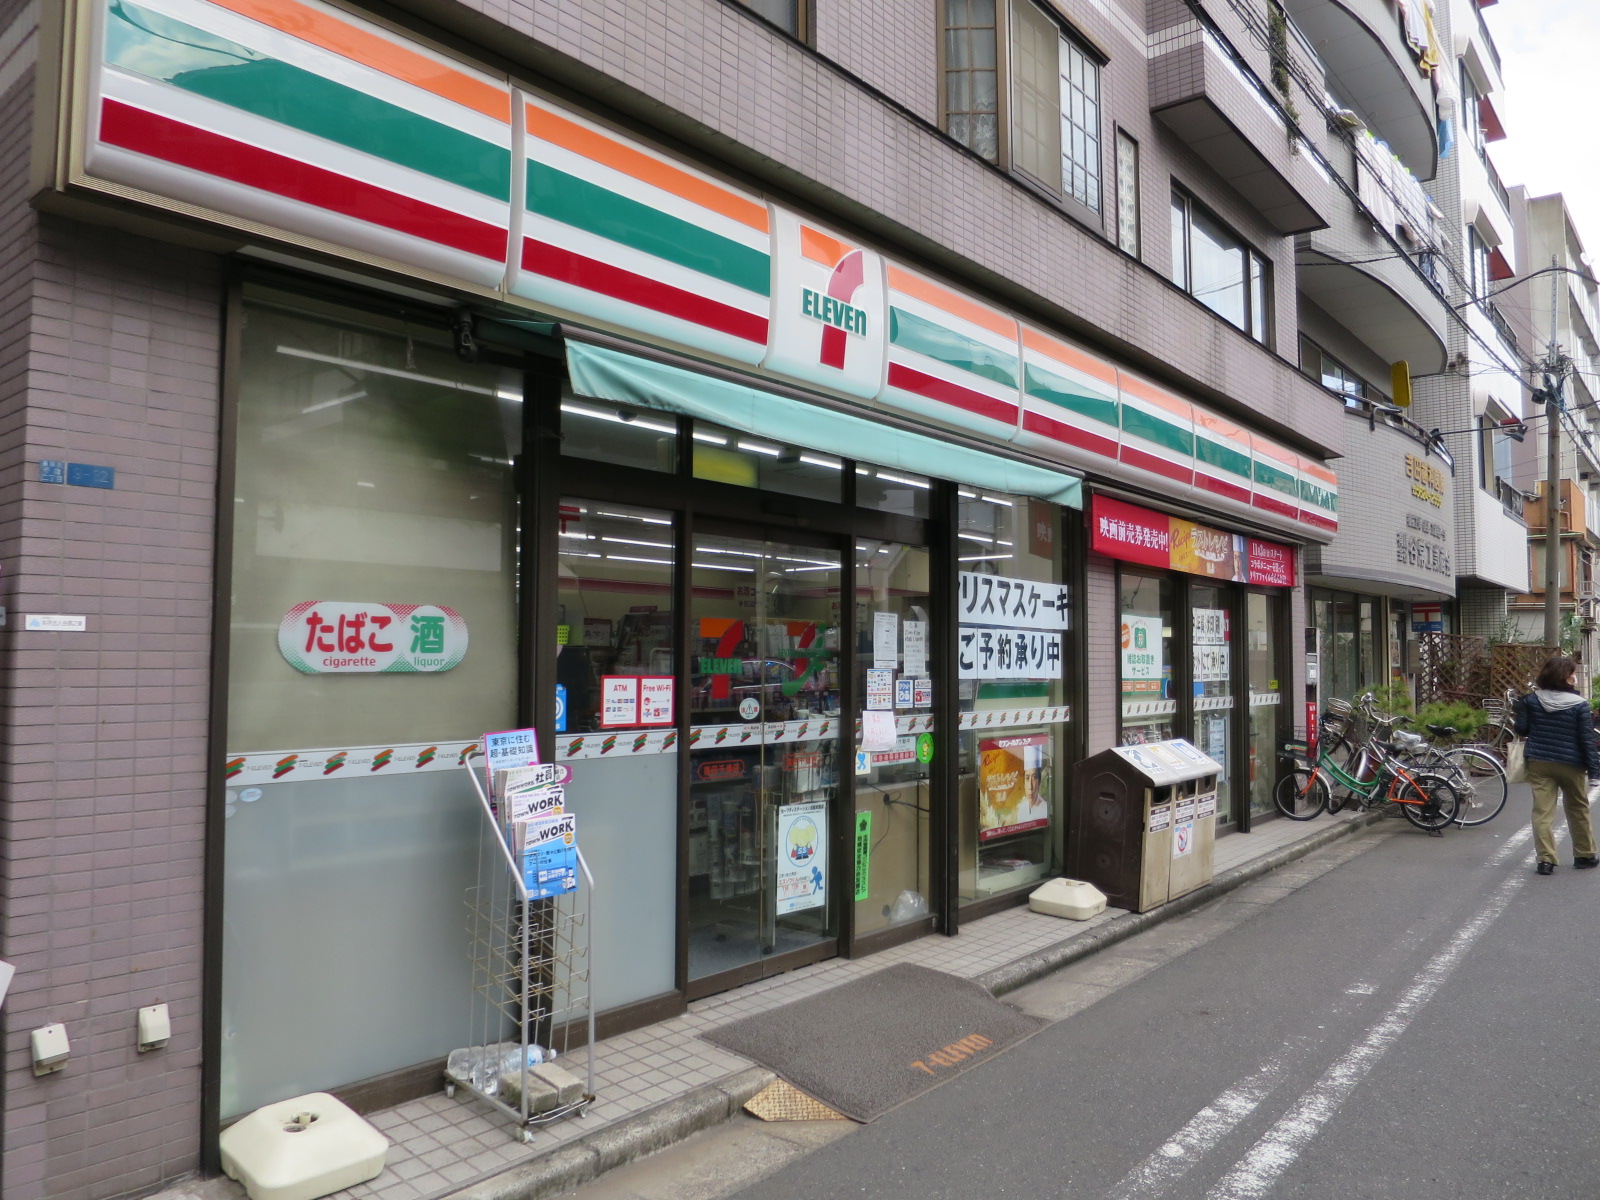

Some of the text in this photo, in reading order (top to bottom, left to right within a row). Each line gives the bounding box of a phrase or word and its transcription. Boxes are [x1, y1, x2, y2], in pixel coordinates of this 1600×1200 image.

[959, 575, 1070, 622] リスマスケーキ
[305, 611, 445, 654] たばこ 酒
[959, 632, 1060, 671] ご予約承り中
[322, 656, 445, 668] cigarette liquor
[1131, 666, 1150, 676] サービス
[613, 684, 628, 692] ATM
[643, 684, 671, 692] Free Wi-Fi
[491, 734, 530, 747] 東京に住む
[535, 768, 553, 783] 社員
[528, 794, 563, 814] WORK
[540, 820, 574, 841] WORK
